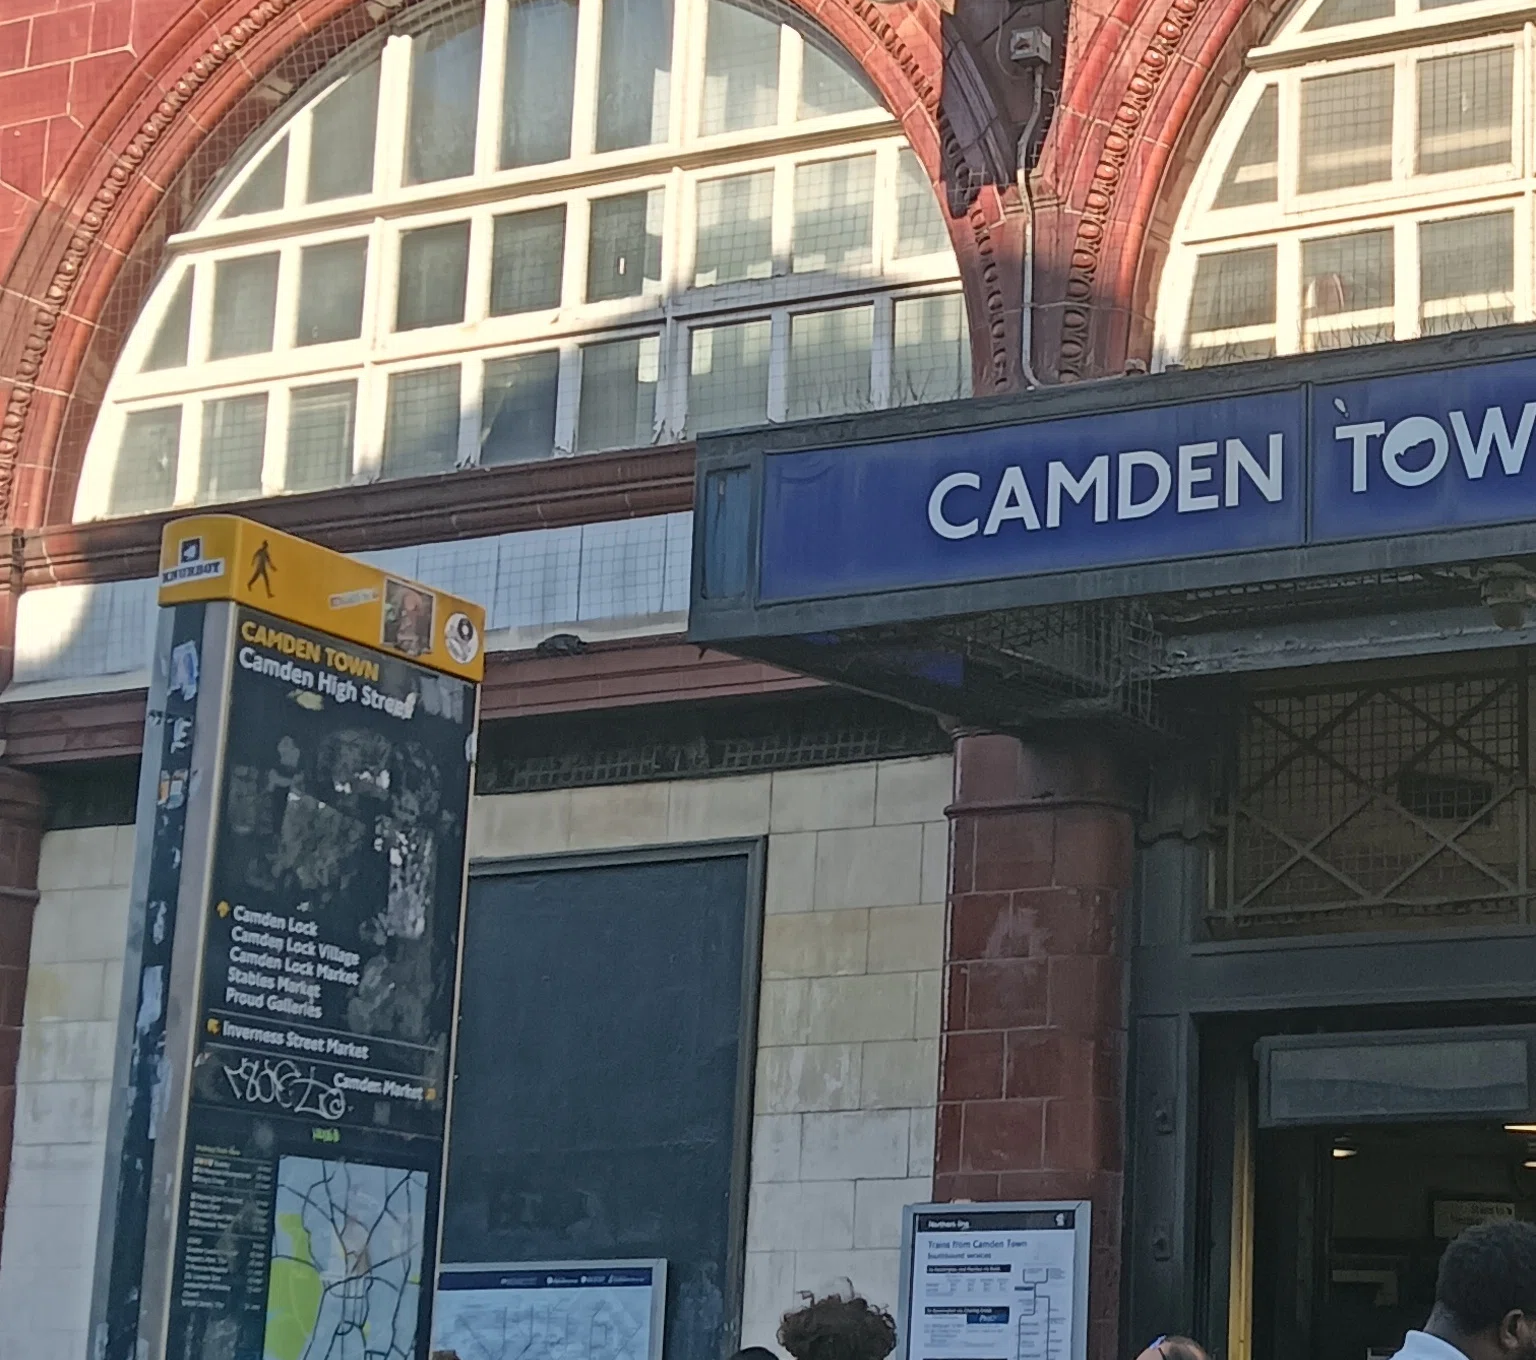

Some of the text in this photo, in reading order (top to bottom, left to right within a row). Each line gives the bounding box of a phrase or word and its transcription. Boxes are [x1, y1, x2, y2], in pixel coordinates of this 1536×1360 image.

[927, 433, 1284, 540] CAMDEN
[241, 620, 379, 682] CAMDEN TOWN
[239, 646, 416, 720] Camden High Street
[233, 904, 318, 937] Camden Lock
[229, 945, 360, 986] Camden Lock Market
[231, 925, 360, 968] Camden Lock Village
[227, 965, 321, 999] Stables Market
[225, 986, 322, 1019] Proud Galleries
[222, 1020, 370, 1060] Inverness Street Market
[333, 1072, 424, 1101] Camden Market
[928, 1238, 1028, 1249] Trains from Camden Town
